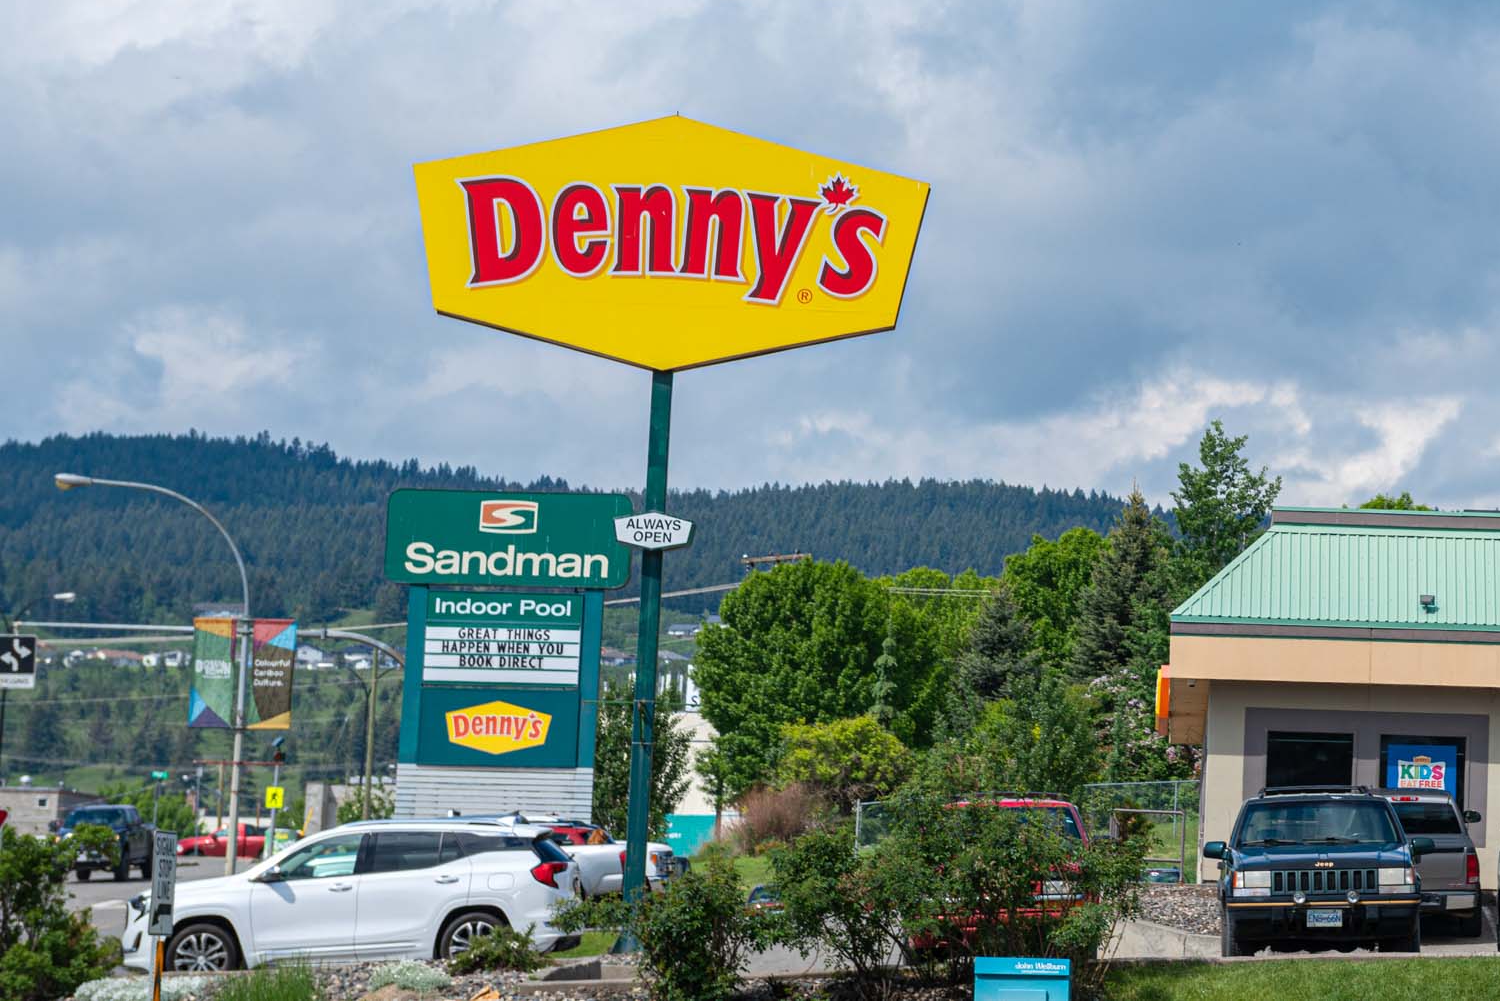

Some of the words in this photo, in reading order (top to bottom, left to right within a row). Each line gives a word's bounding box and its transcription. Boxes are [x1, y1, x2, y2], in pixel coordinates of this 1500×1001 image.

[456, 171, 887, 306] Denny's
[625, 518, 682, 532] ALWAYS
[633, 531, 673, 544] OPEN
[405, 541, 609, 578] Sandman
[434, 597, 512, 616] Indoor
[519, 599, 572, 617] Pool
[458, 627, 498, 640] GREAT
[506, 628, 551, 641] THINGS
[441, 641, 490, 654] HAPPEN
[496, 642, 532, 655] WHEN
[538, 643, 564, 656] YOU
[458, 655, 493, 668] BOOK
[499, 656, 544, 670] DIRECT
[452, 712, 543, 741] Denny's
[1400, 764, 1444, 780] KIDS
[1419, 780, 1443, 788] FREE
[158, 858, 173, 878] STOP
